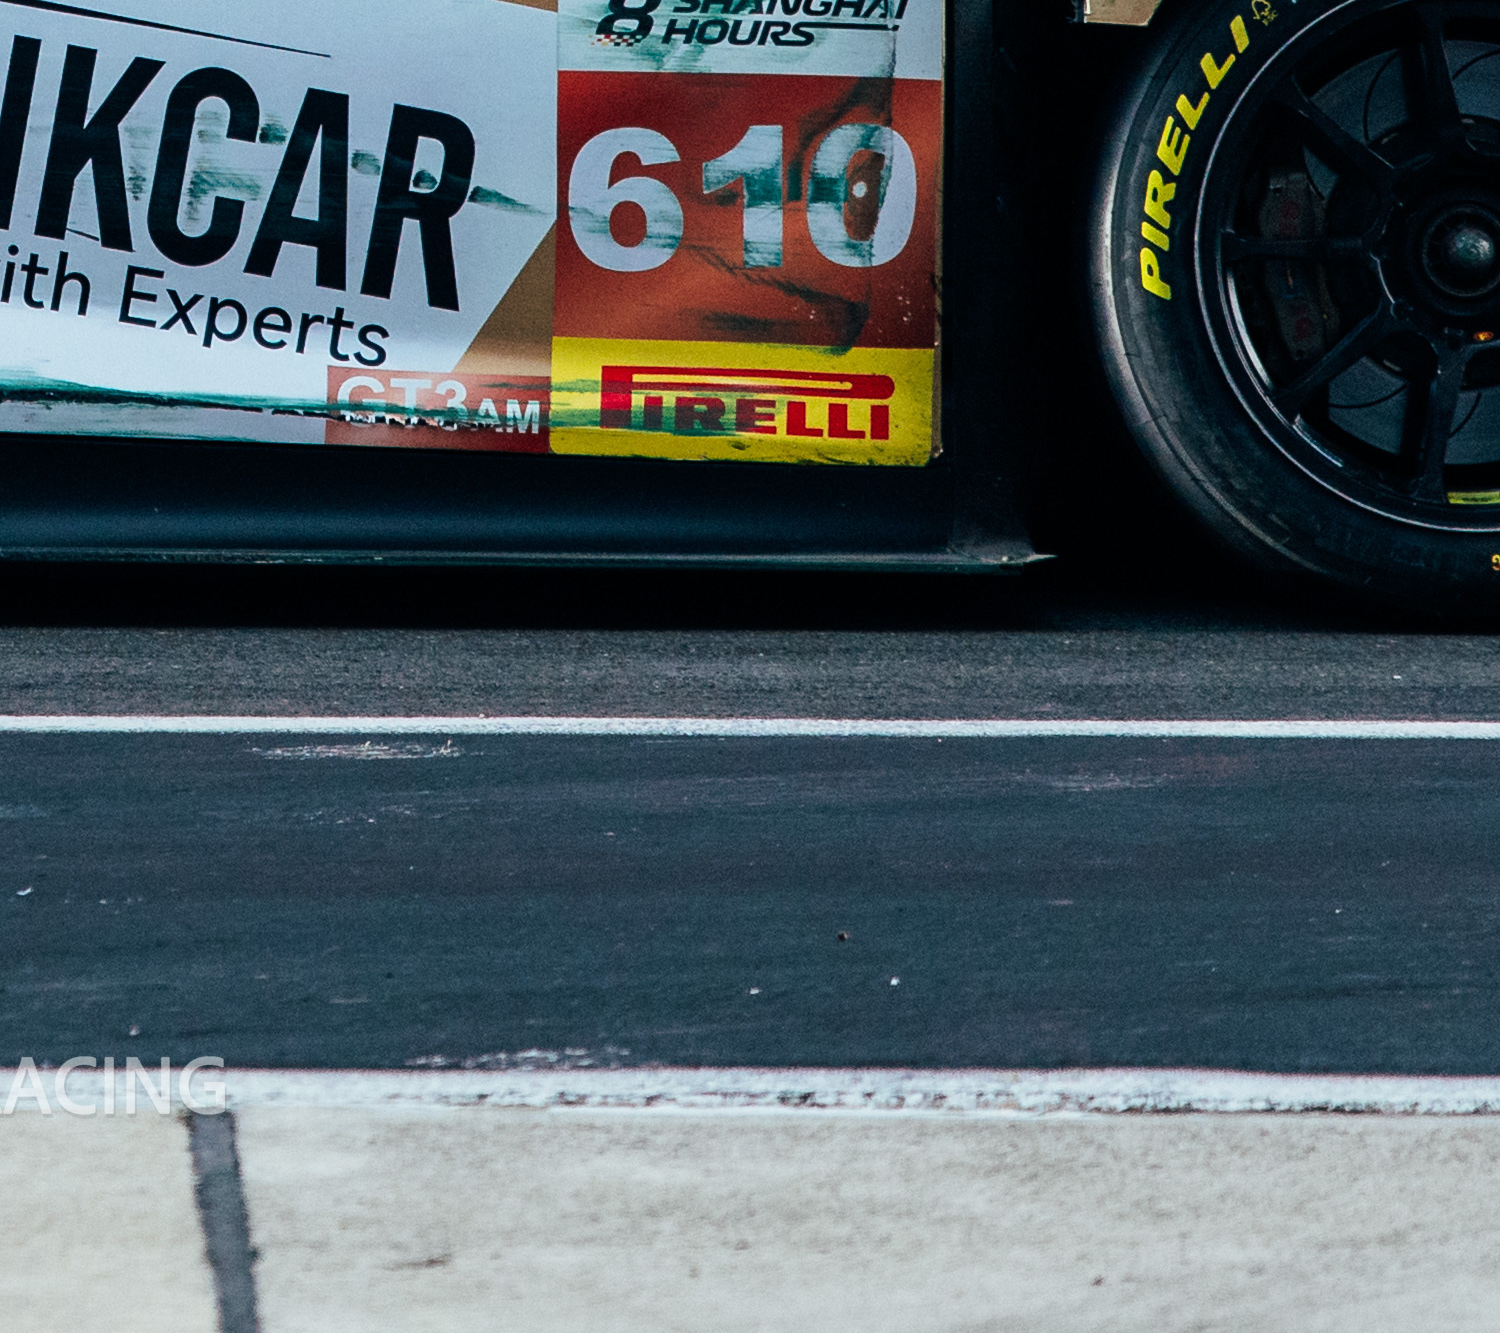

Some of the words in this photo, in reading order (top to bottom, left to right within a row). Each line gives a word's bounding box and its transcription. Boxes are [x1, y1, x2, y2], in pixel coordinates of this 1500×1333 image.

[660, 18, 816, 48] HOURS
[567, 122, 919, 273] 610
[1139, 14, 1250, 300] PIRELLI
[119, 264, 391, 368] Experts
[599, 364, 897, 443] PIRELLI
